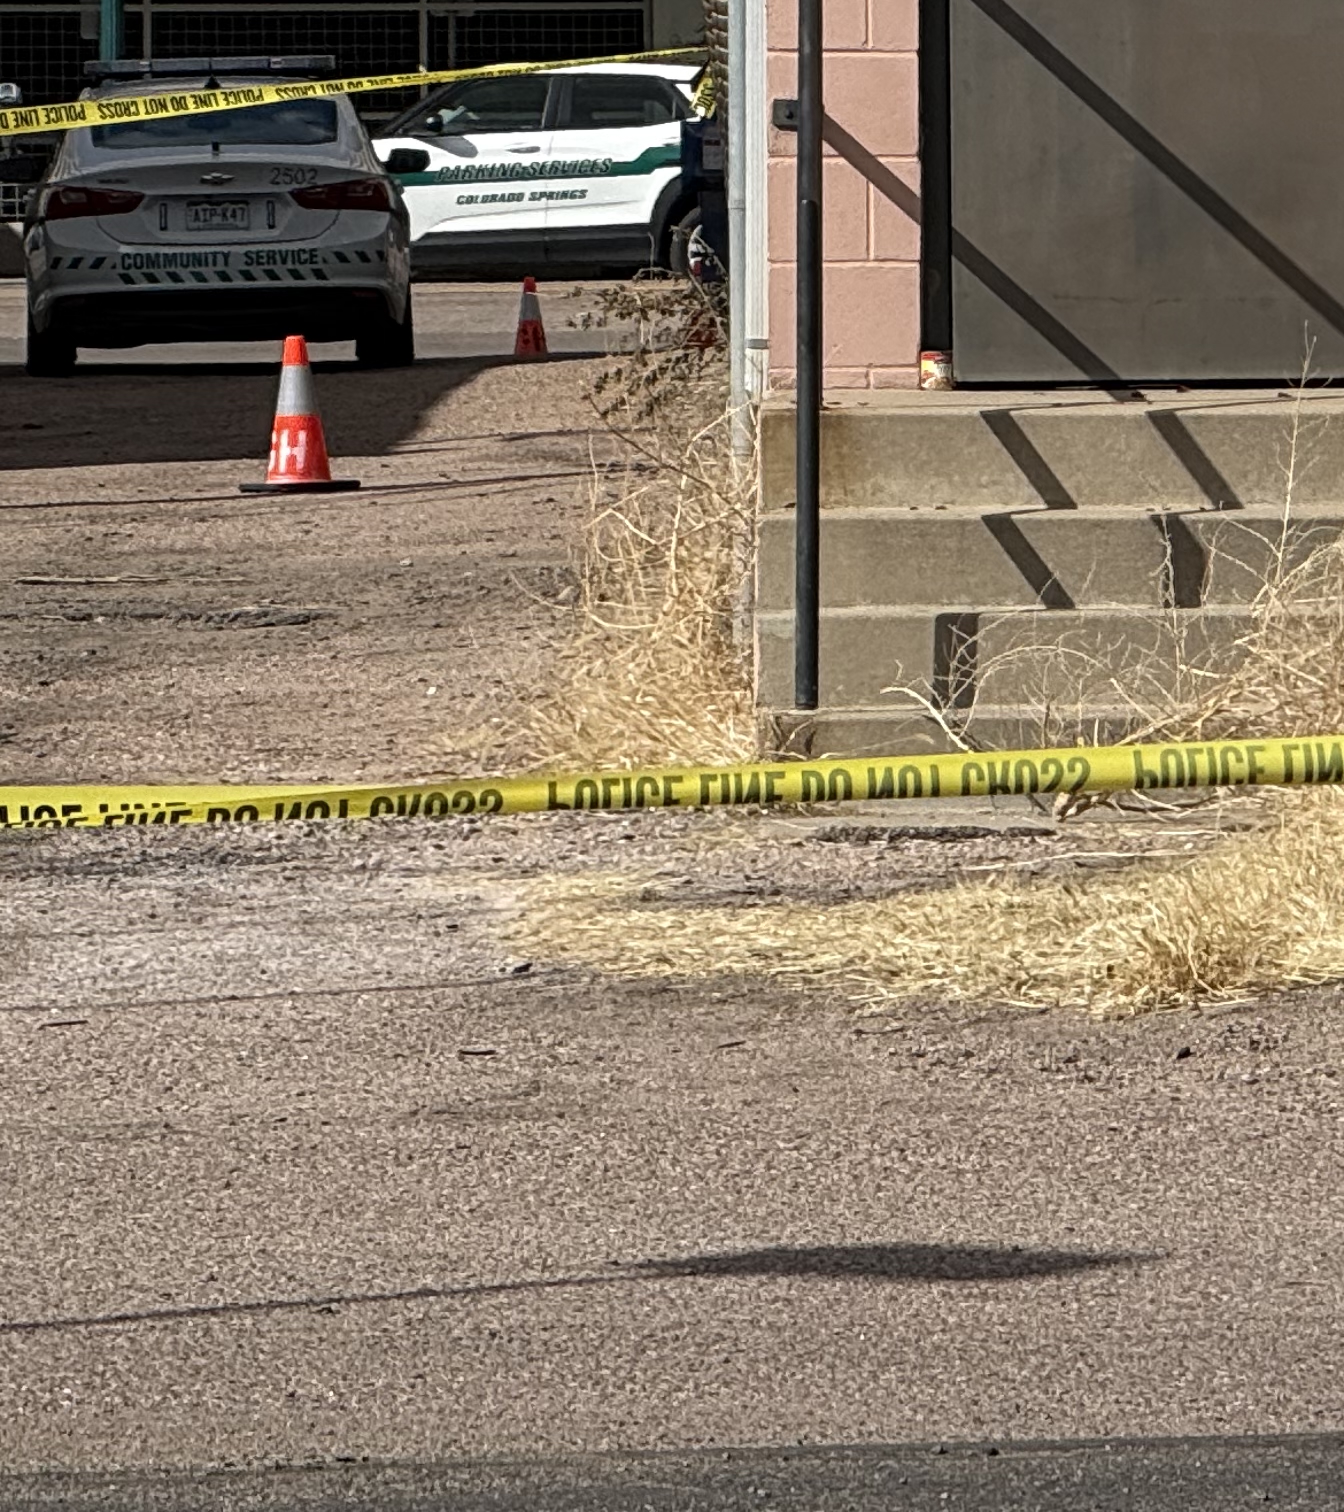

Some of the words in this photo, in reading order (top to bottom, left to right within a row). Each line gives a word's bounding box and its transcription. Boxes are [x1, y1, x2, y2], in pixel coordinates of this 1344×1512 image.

[144, 97, 170, 115] NOT
[171, 96, 188, 112] DO
[189, 91, 220, 109] LINE
[224, 89, 265, 106] POLICE
[13, 108, 40, 128] LINE
[44, 103, 88, 126] POLICE
[98, 102, 141, 120] CROSS
[270, 167, 318, 185] 2502
[438, 162, 523, 181] PARKING
[528, 158, 612, 176] SERVICES
[456, 192, 525, 205] COLORADO
[528, 189, 588, 201] SPRINGS
[121, 250, 231, 270] COMMUNITY
[244, 248, 318, 266] SERVICE
